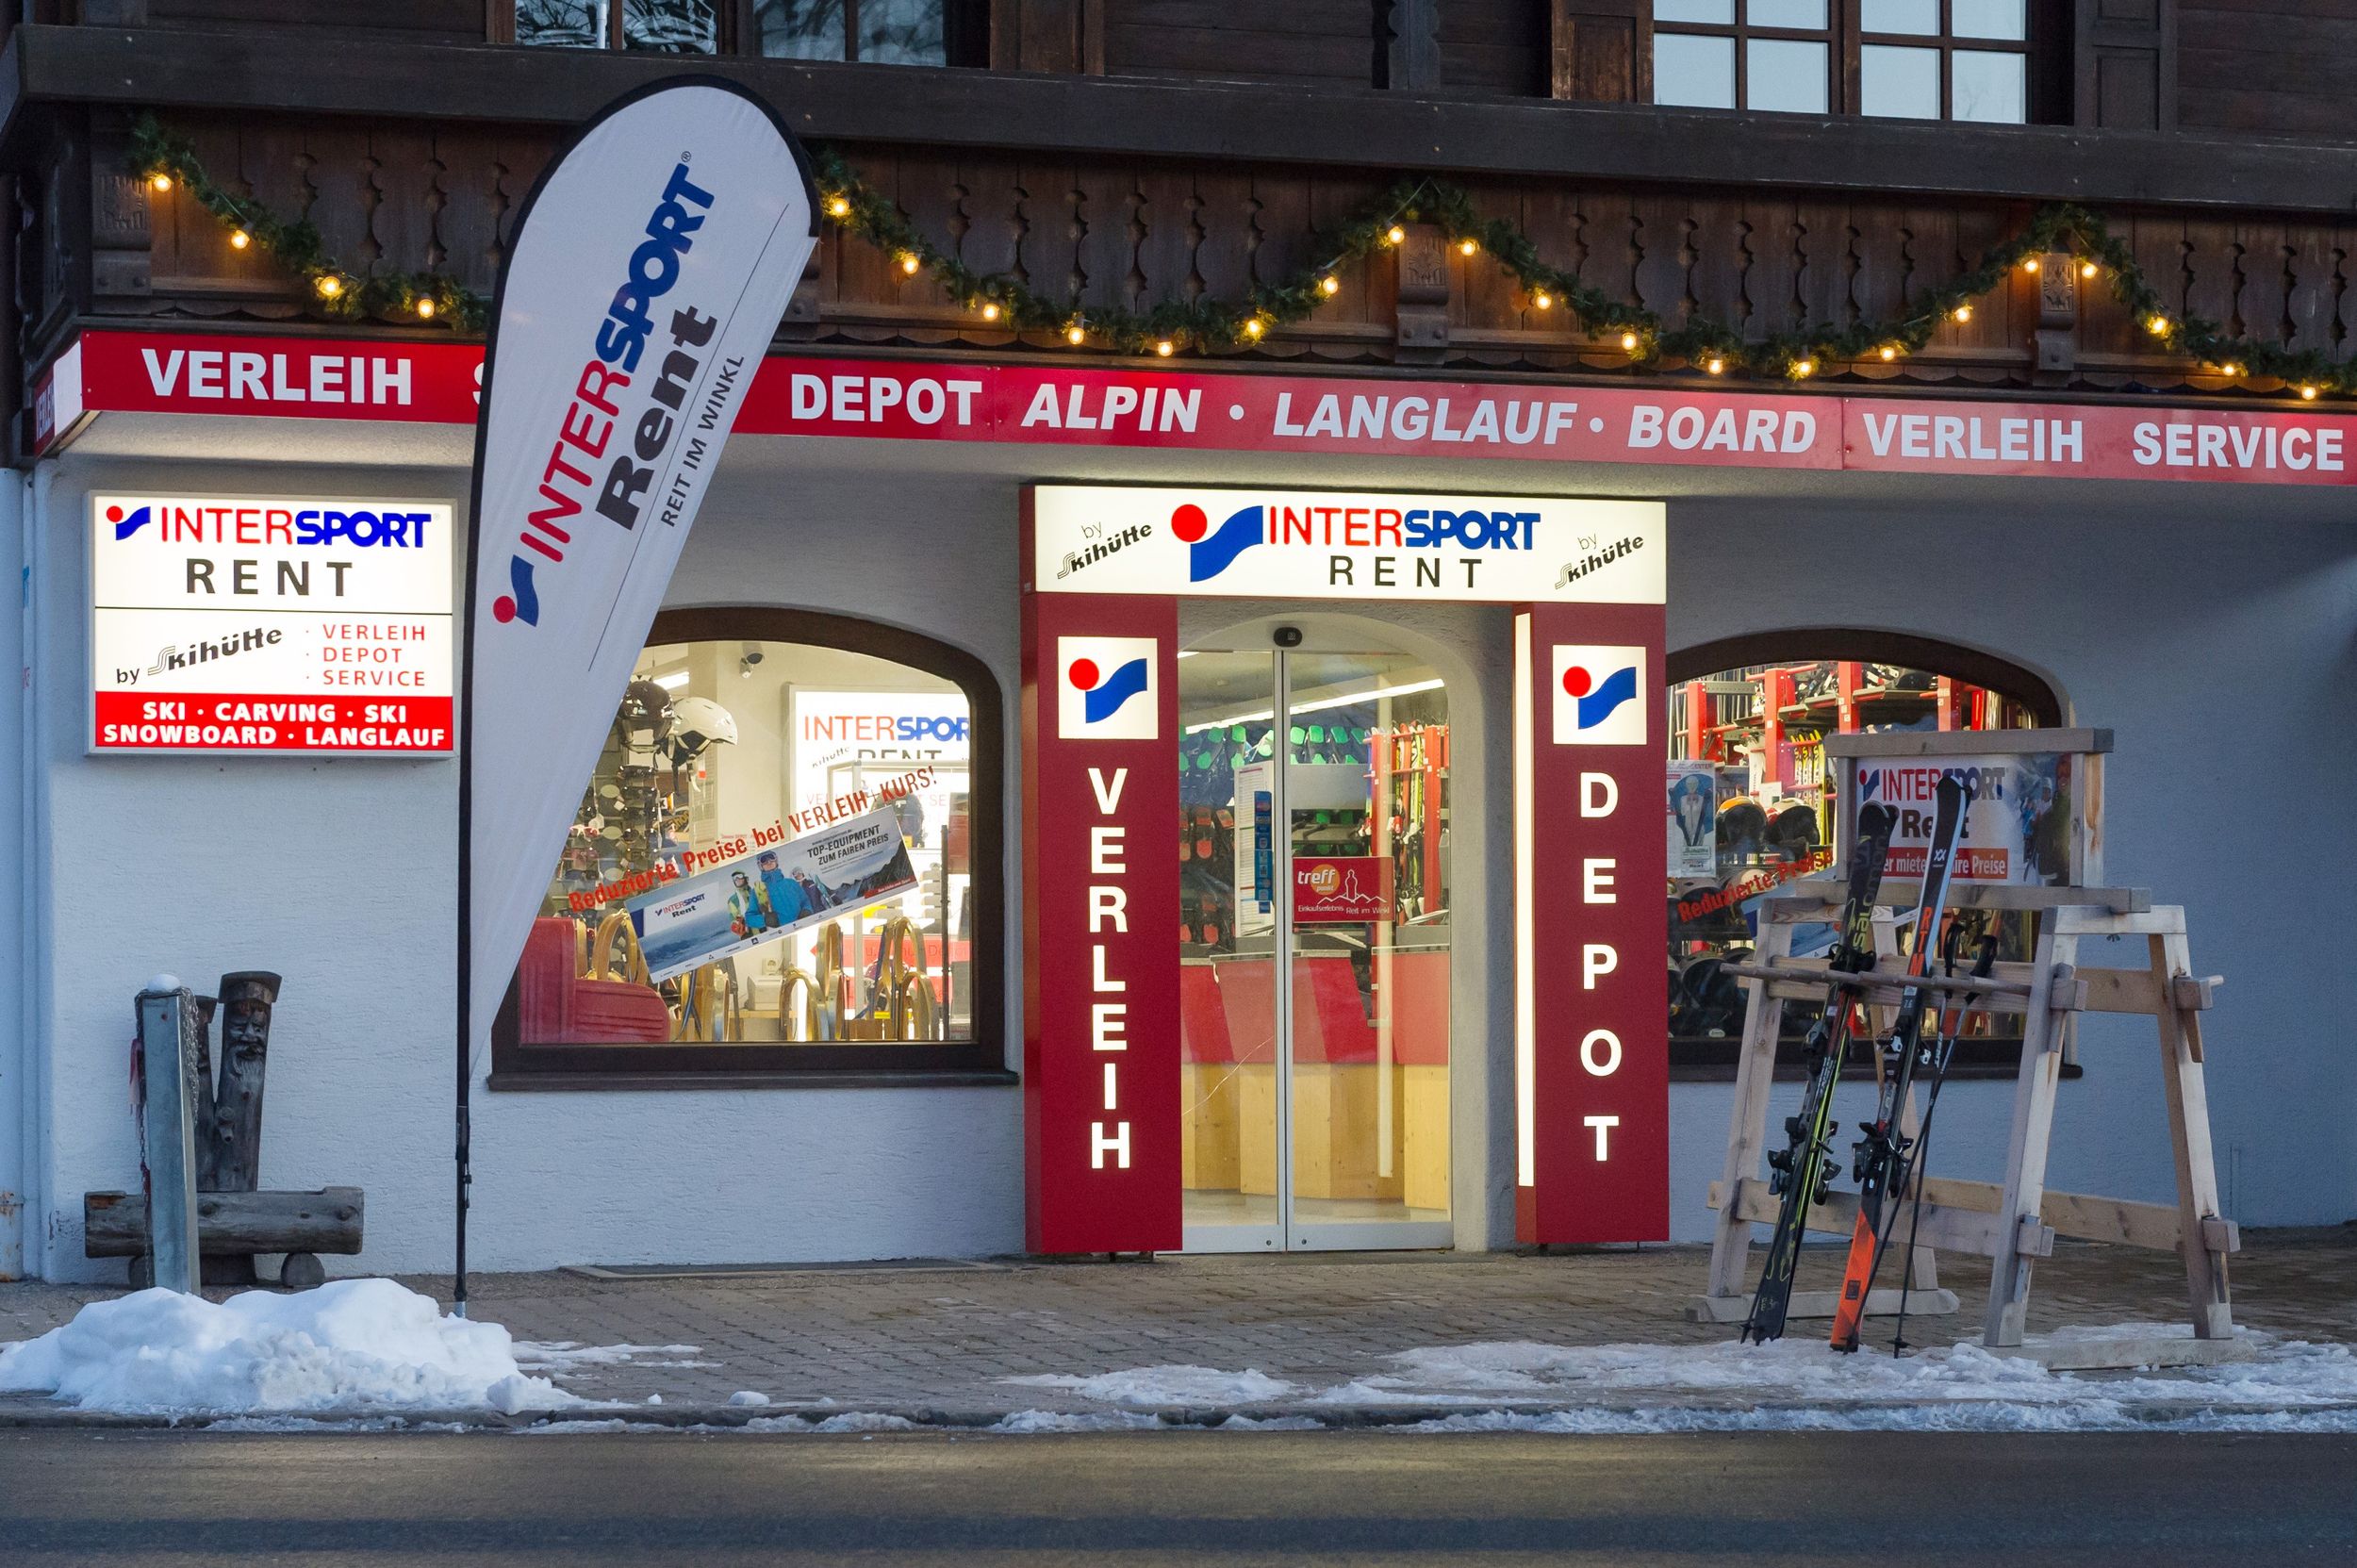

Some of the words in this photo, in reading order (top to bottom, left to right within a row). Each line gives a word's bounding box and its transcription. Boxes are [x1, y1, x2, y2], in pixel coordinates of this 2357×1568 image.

[141, 349, 412, 405] VERLEIH
[792, 374, 981, 425] DEPOT
[595, 305, 717, 531] Rent
[1021, 384, 1201, 432] ALPIN
[1274, 392, 1578, 442] LANGLAUF
[1628, 405, 1816, 454] BOARD
[661, 469, 692, 528] REIT
[684, 437, 707, 470] IM
[699, 355, 745, 433] WINKL
[1863, 412, 2084, 463] VERLEIH
[2133, 421, 2344, 471] SERVICE
[161, 506, 432, 548] INTERSPORT
[1081, 521, 1101, 539] by
[1270, 506, 1541, 550] INTERSPORT
[1577, 533, 1597, 550] by
[187, 558, 353, 597] RENT
[1330, 555, 1482, 588] RENT
[322, 623, 425, 641] VERLEIH
[322, 646, 402, 663] DEPOT
[117, 668, 140, 685] by
[322, 669, 425, 687] SERVICE
[143, 701, 186, 720] SKI
[215, 702, 336, 723] CARVING
[365, 704, 406, 723] SKI
[104, 724, 277, 745] SNOWBOARD
[305, 728, 445, 747] LANGLAUF
[804, 716, 970, 742] INTERSPOR
[1902, 809, 1970, 838] Ret
[807, 824, 881, 858] TOP-EQUIPMENT
[818, 850, 836, 866] ZUM
[837, 841, 865, 859] FAIREN
[866, 833, 889, 850] PREIS
[568, 859, 678, 913] Reduzierte
[682, 838, 748, 873] Preise
[751, 819, 785, 848] bei
[1297, 868, 1335, 884] treff
[1896, 852, 1927, 873] miete
[1971, 855, 2005, 875] Preise
[663, 893, 705, 915] INTERSPORT
[672, 905, 697, 918] Rent
[1677, 871, 1774, 922] Reduzierte
[1088, 767, 1129, 1168] VERLEIH
[1580, 772, 1622, 1162] DEPOT
